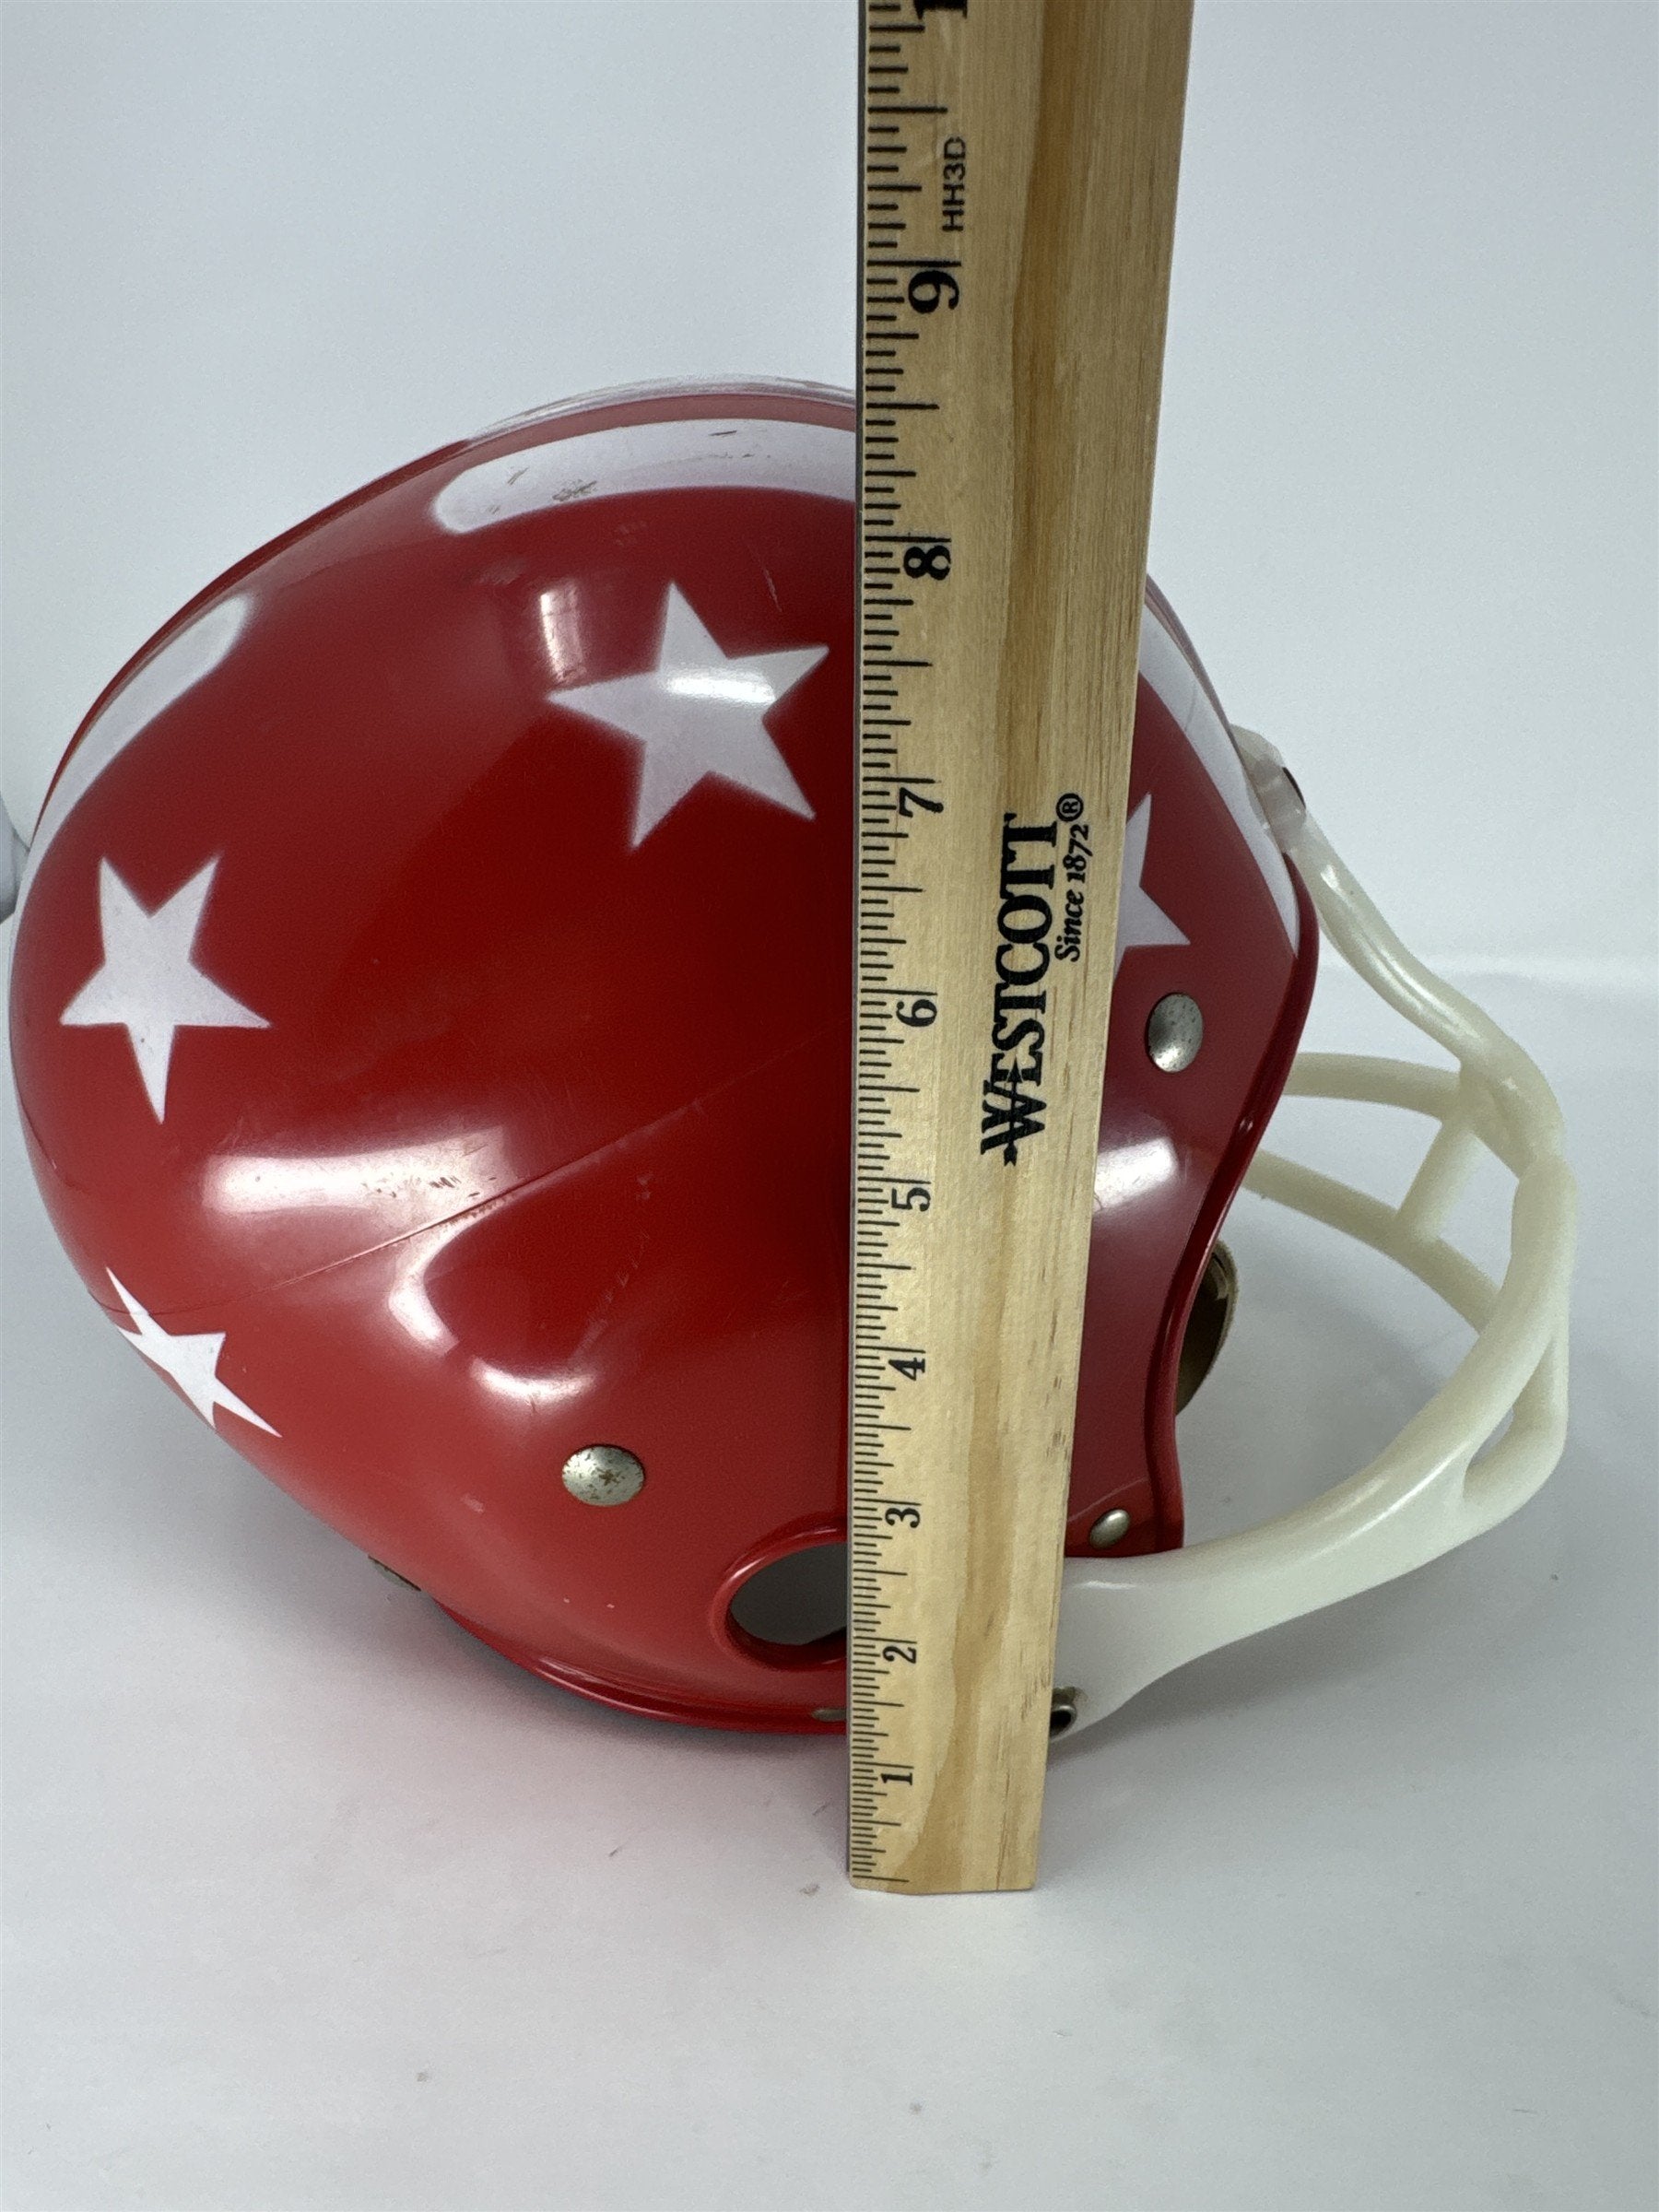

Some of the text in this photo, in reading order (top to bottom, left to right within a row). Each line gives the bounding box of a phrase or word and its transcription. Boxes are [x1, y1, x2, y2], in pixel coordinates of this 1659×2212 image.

[942, 136, 966, 231] HH3D
[907, 269, 960, 314] 9
[902, 545, 952, 581] 8
[898, 786, 945, 818] 7
[1053, 824, 1094, 962] Since 1872
[980, 812, 1058, 1166] WESTCOTT
[895, 998, 938, 1028] 6
[891, 1187, 932, 1212] 5
[888, 1357, 926, 1382] 4
[884, 1507, 921, 1529] 3
[882, 1645, 917, 1665] 2
[880, 1772, 913, 1786] 1
